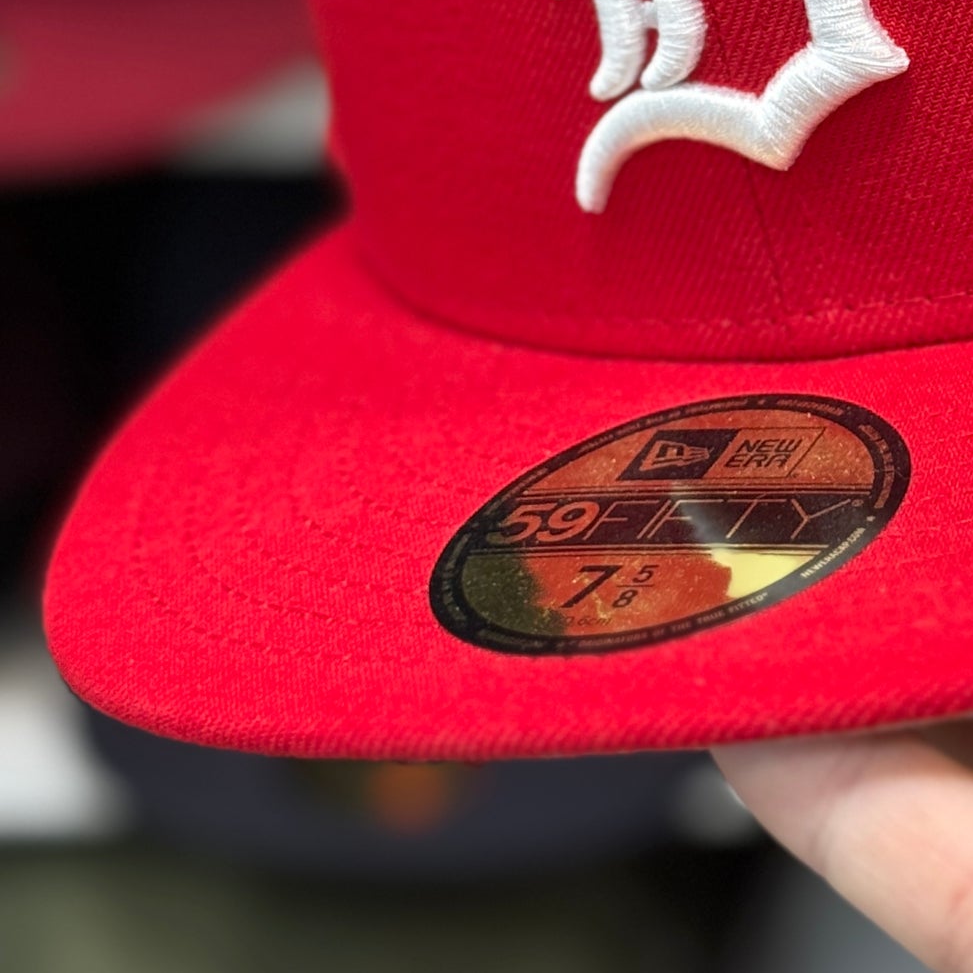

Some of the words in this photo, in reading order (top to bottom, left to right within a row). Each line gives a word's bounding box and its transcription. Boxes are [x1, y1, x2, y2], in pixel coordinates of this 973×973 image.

[737, 438, 801, 453] NEW
[723, 454, 791, 469] ERA
[561, 565, 621, 608] 7
[670, 620, 693, 634] THE
[697, 610, 725, 624] TRUE
